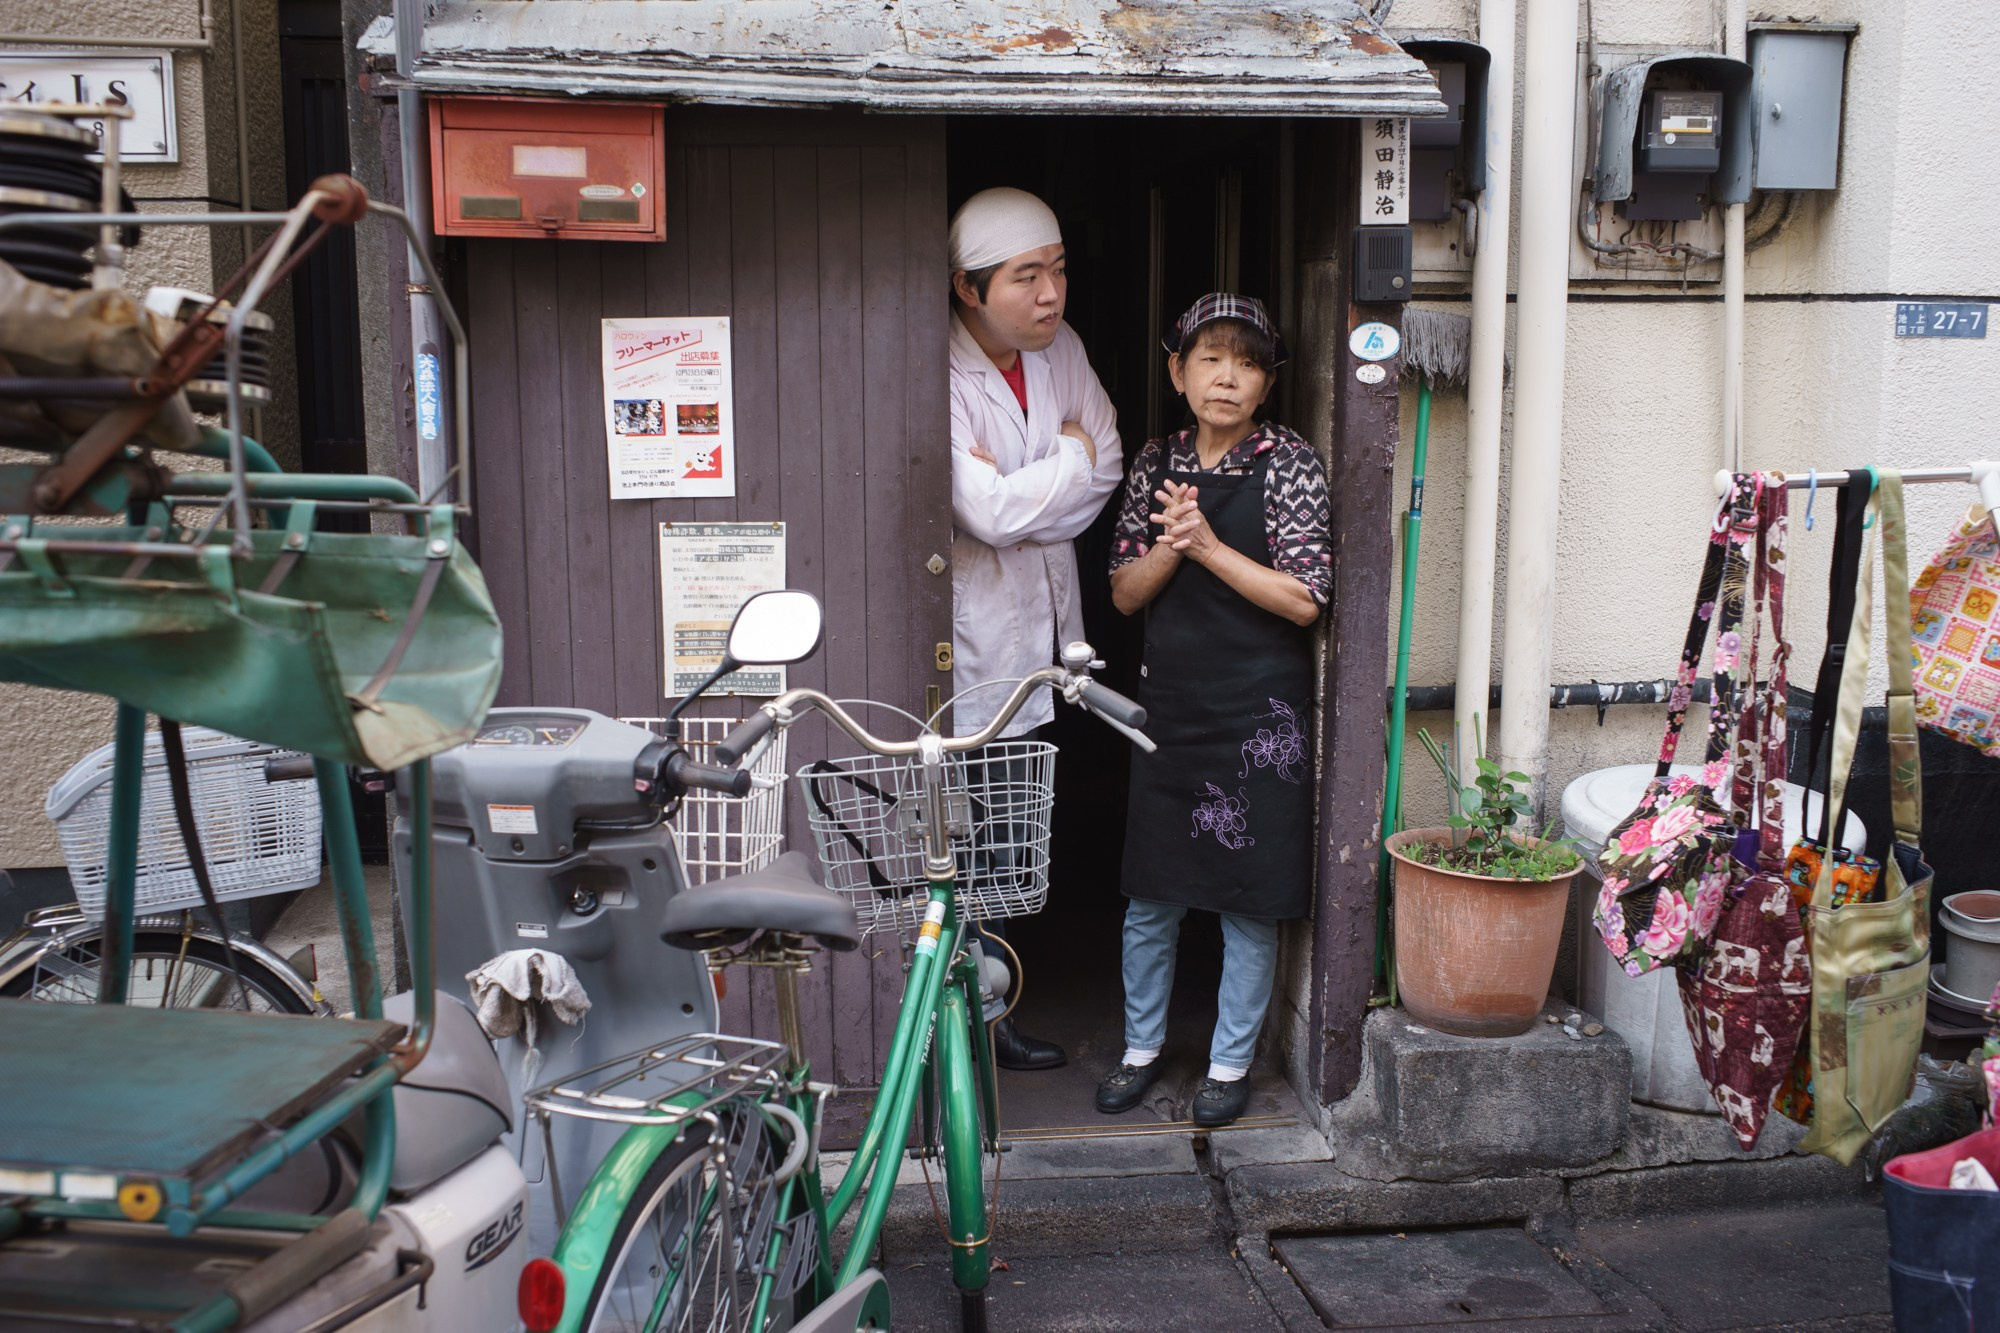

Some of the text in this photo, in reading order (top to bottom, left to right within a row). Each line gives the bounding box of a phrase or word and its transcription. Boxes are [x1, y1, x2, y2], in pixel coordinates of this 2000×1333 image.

[1898, 313, 1926, 324] 池上
[1933, 310, 1982, 330] 27-7
[1897, 325, 1925, 335] 四丁目
[616, 331, 691, 360] フリーマーケット
[680, 351, 721, 362] 出店募集
[466, 1199, 524, 1263] GEAR
